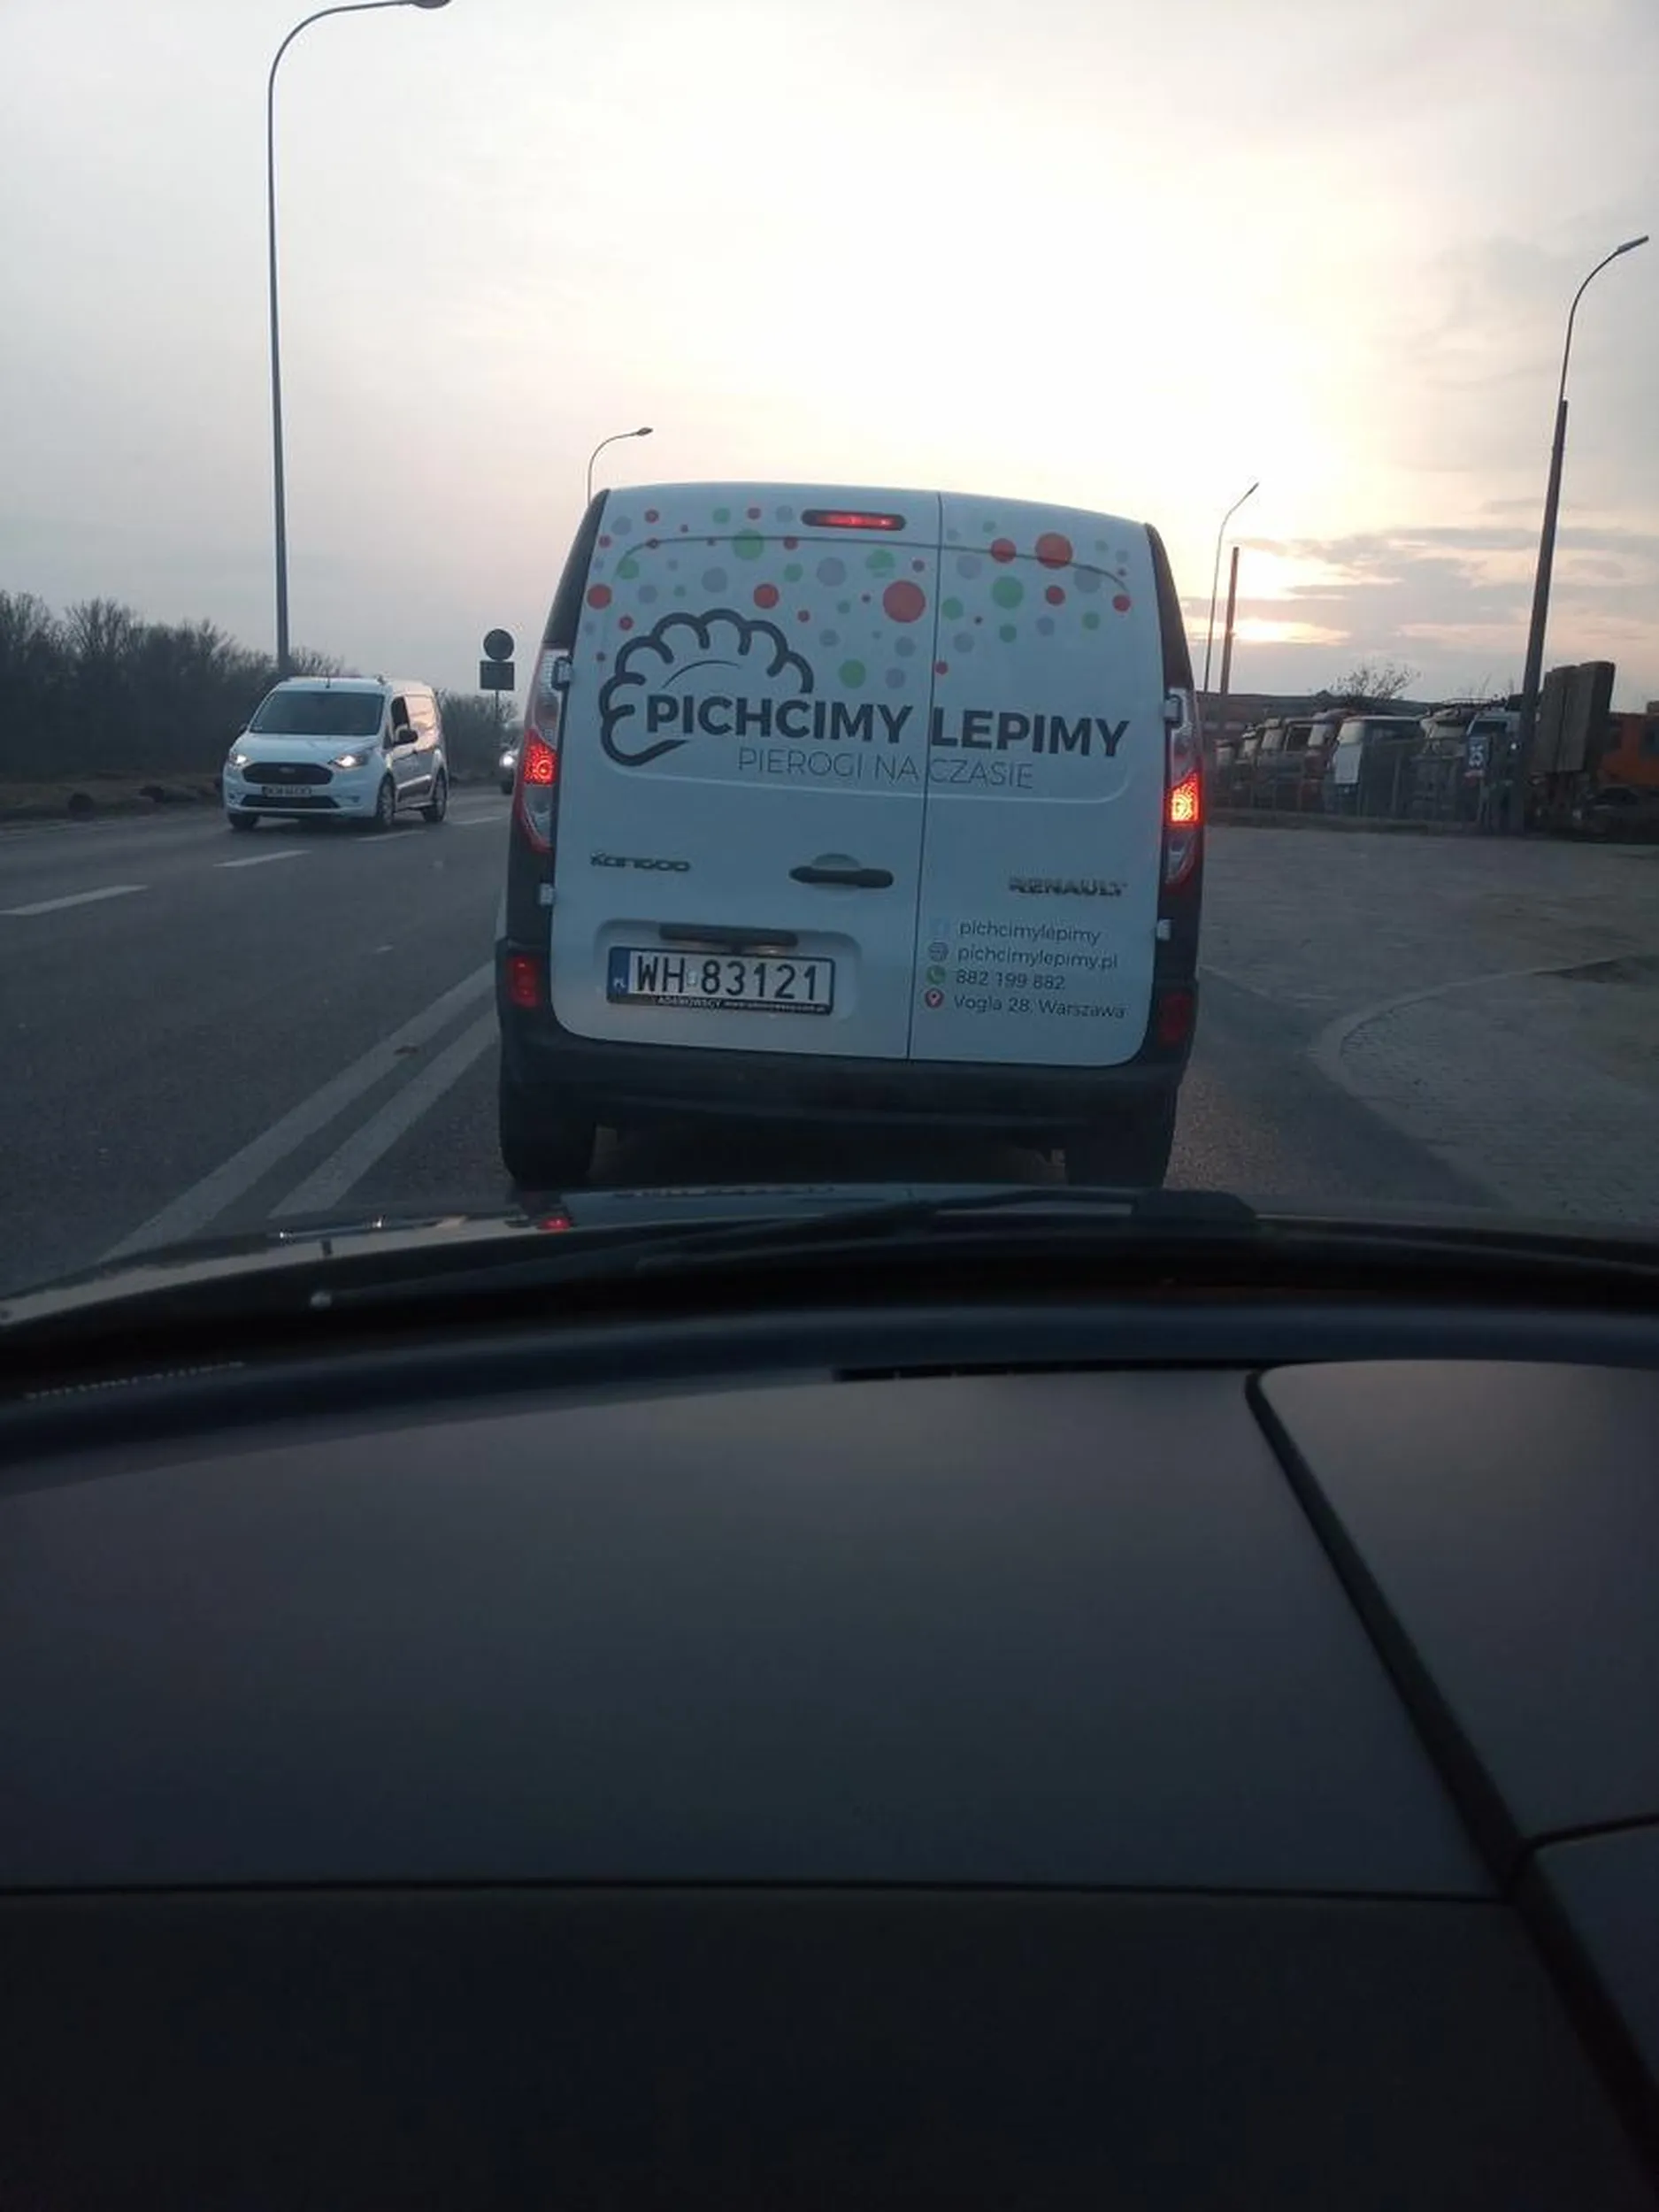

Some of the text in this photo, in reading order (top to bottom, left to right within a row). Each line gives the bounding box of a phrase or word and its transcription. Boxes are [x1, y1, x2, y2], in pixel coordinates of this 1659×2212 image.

[647, 694, 1130, 757] PICHCIMY LEPIMY
[738, 747, 1034, 789] PIEROGI NA CZASIE
[1009, 876, 1126, 896] RENAULT
[959, 919, 1102, 945] pichcimylepimy
[956, 943, 1118, 971] pichcimylepimy.pl
[637, 955, 817, 1002] WH 83121
[995, 972, 1028, 989] 199
